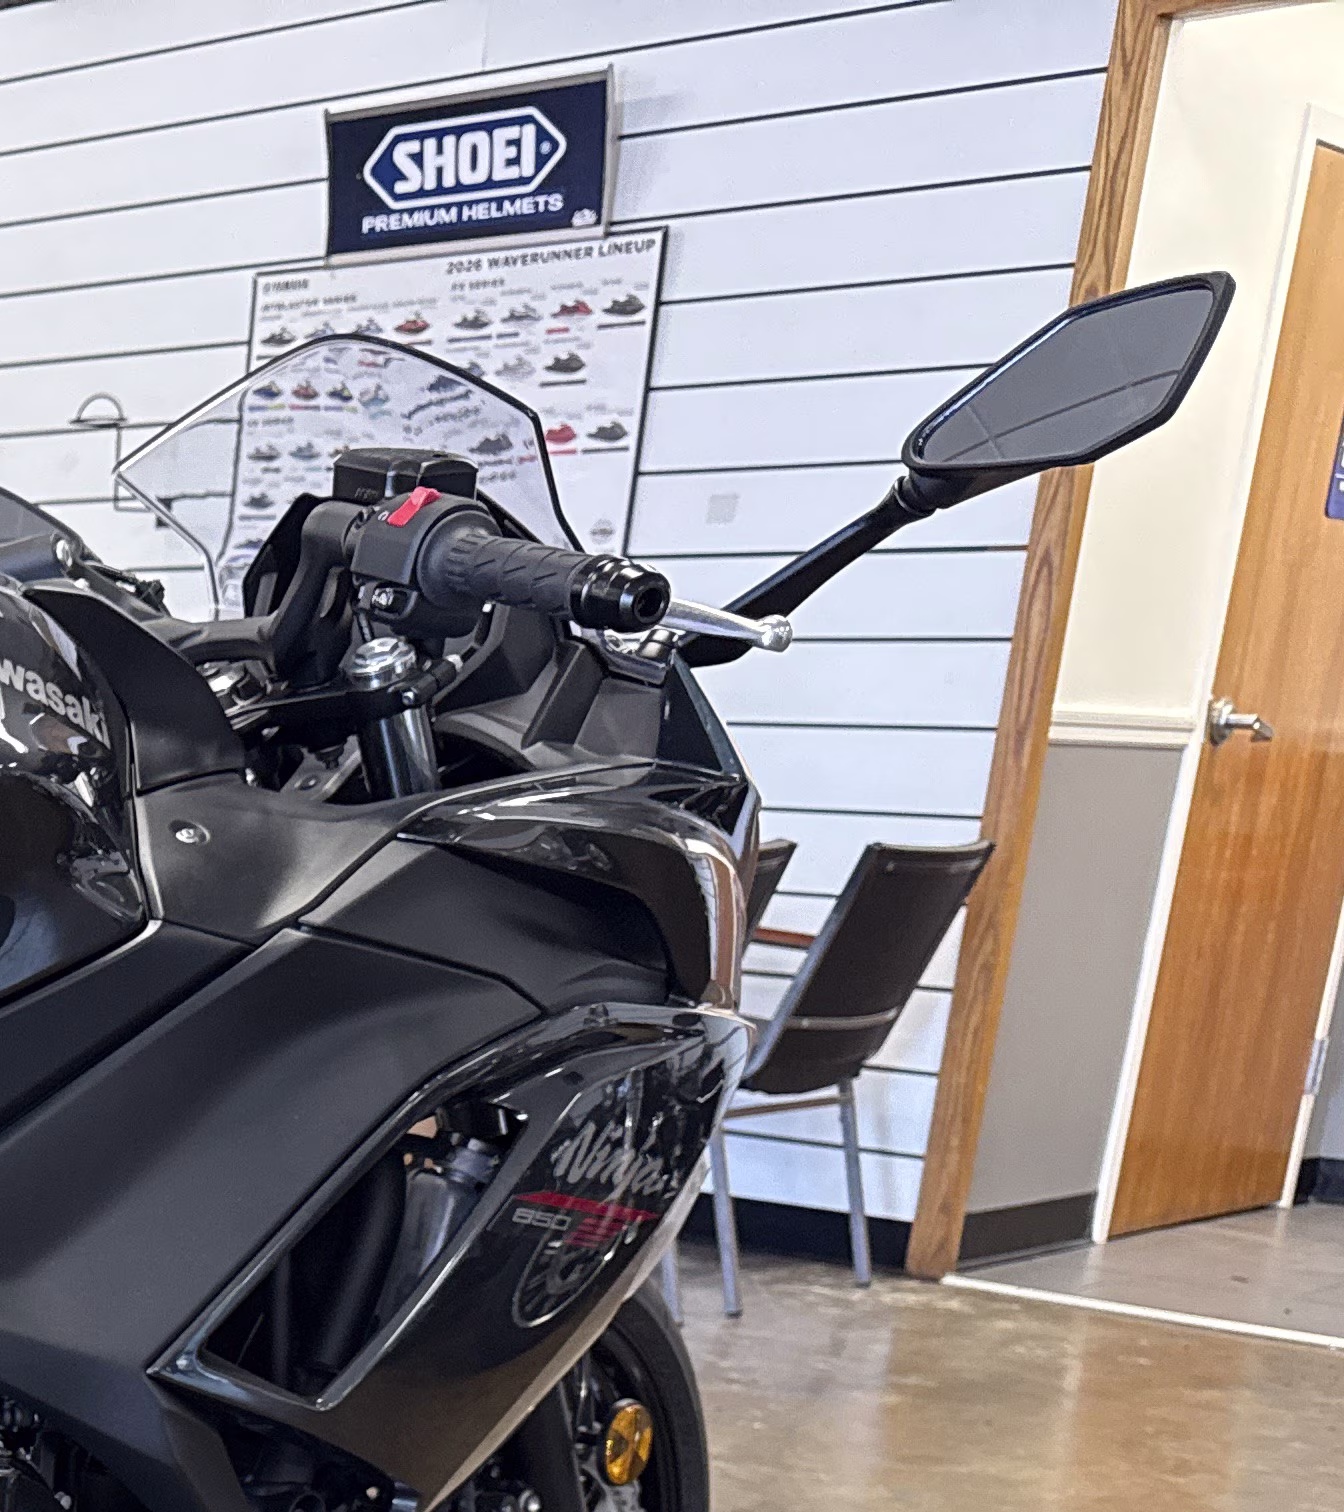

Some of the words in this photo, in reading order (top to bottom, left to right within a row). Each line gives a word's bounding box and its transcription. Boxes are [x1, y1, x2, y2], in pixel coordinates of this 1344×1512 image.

[392, 123, 537, 195] SHOEI
[362, 205, 458, 234] PREMIUM
[462, 193, 564, 221] HELMETS
[487, 245, 595, 270] WAVERUNNER
[598, 238, 657, 258] LINEUP
[550, 1119, 671, 1208] Ninja
